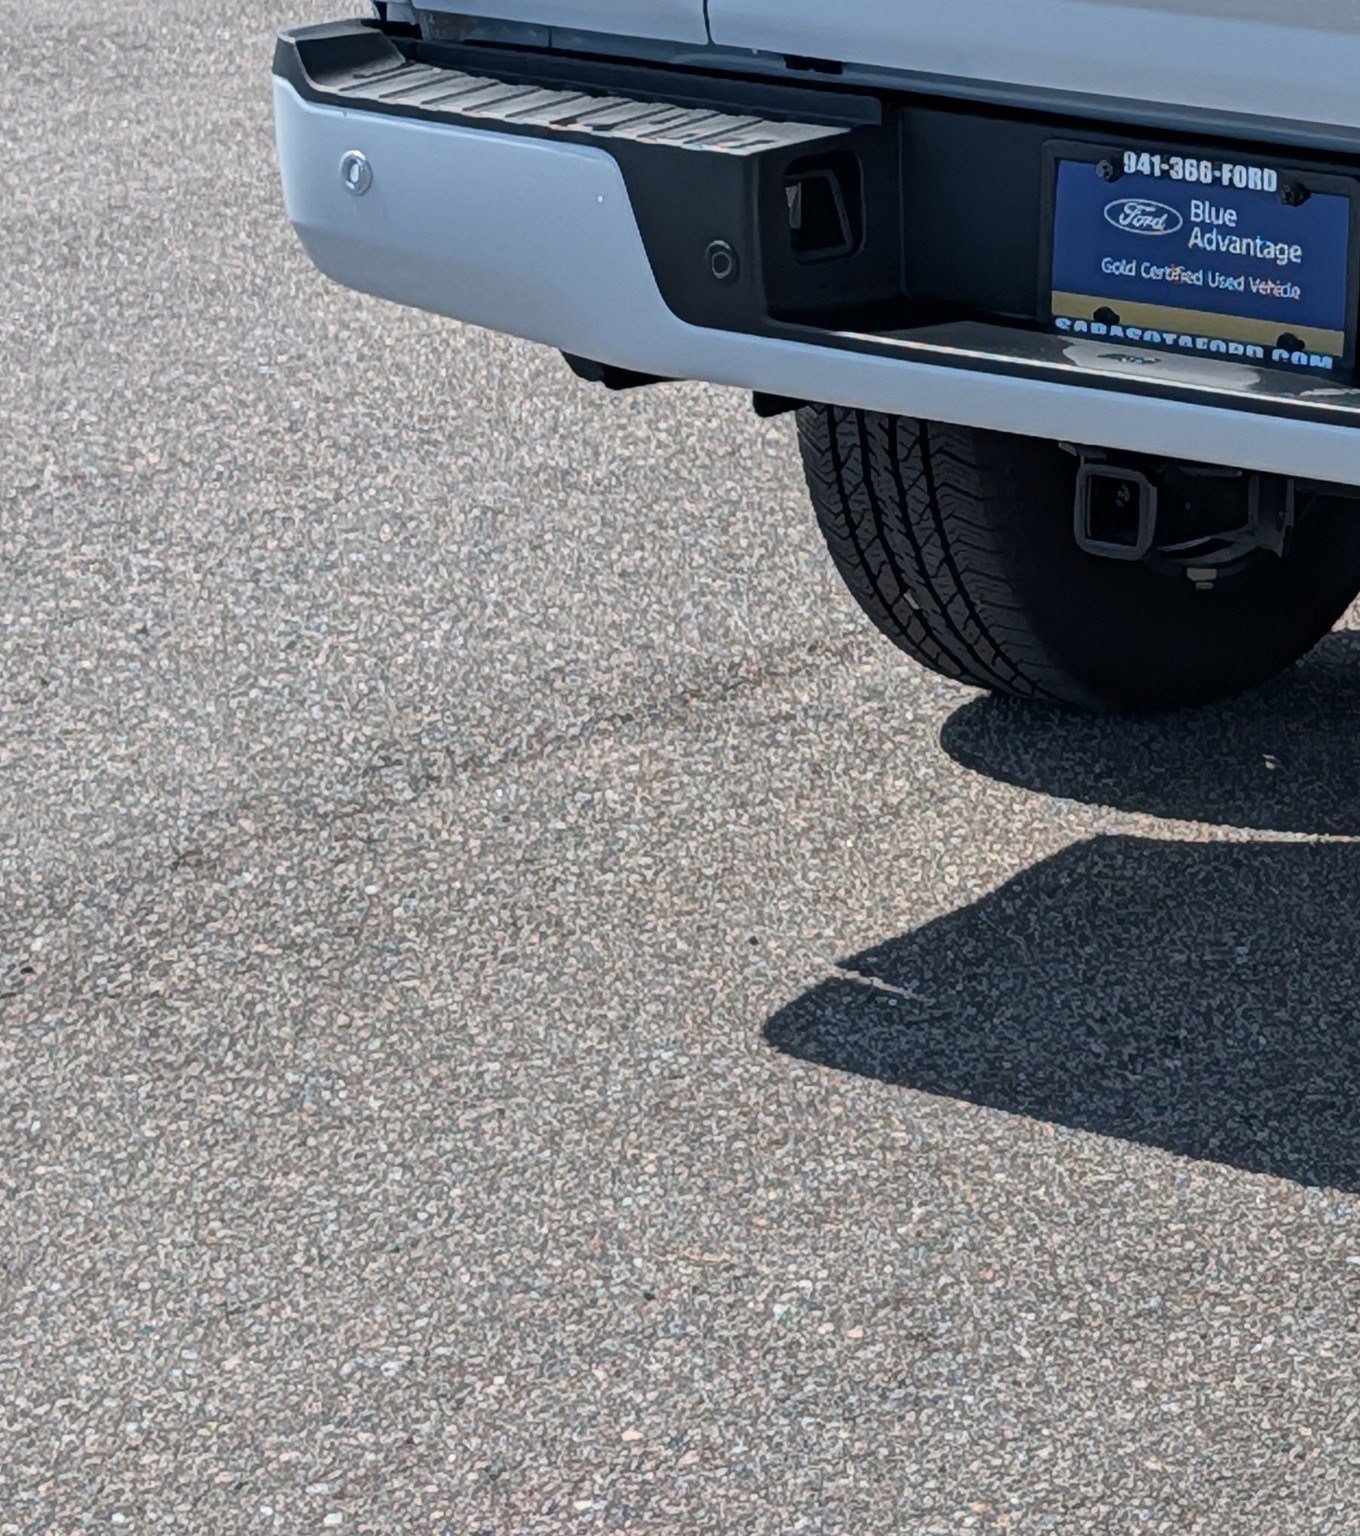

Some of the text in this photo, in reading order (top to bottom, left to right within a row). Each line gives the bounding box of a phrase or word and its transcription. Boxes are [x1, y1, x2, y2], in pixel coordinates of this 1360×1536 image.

[1118, 202, 1168, 231] Ford
[1189, 199, 1238, 227] Blue
[1187, 226, 1303, 266] Advantage
[1101, 257, 1302, 301] Gold Certified Used Vehicle
